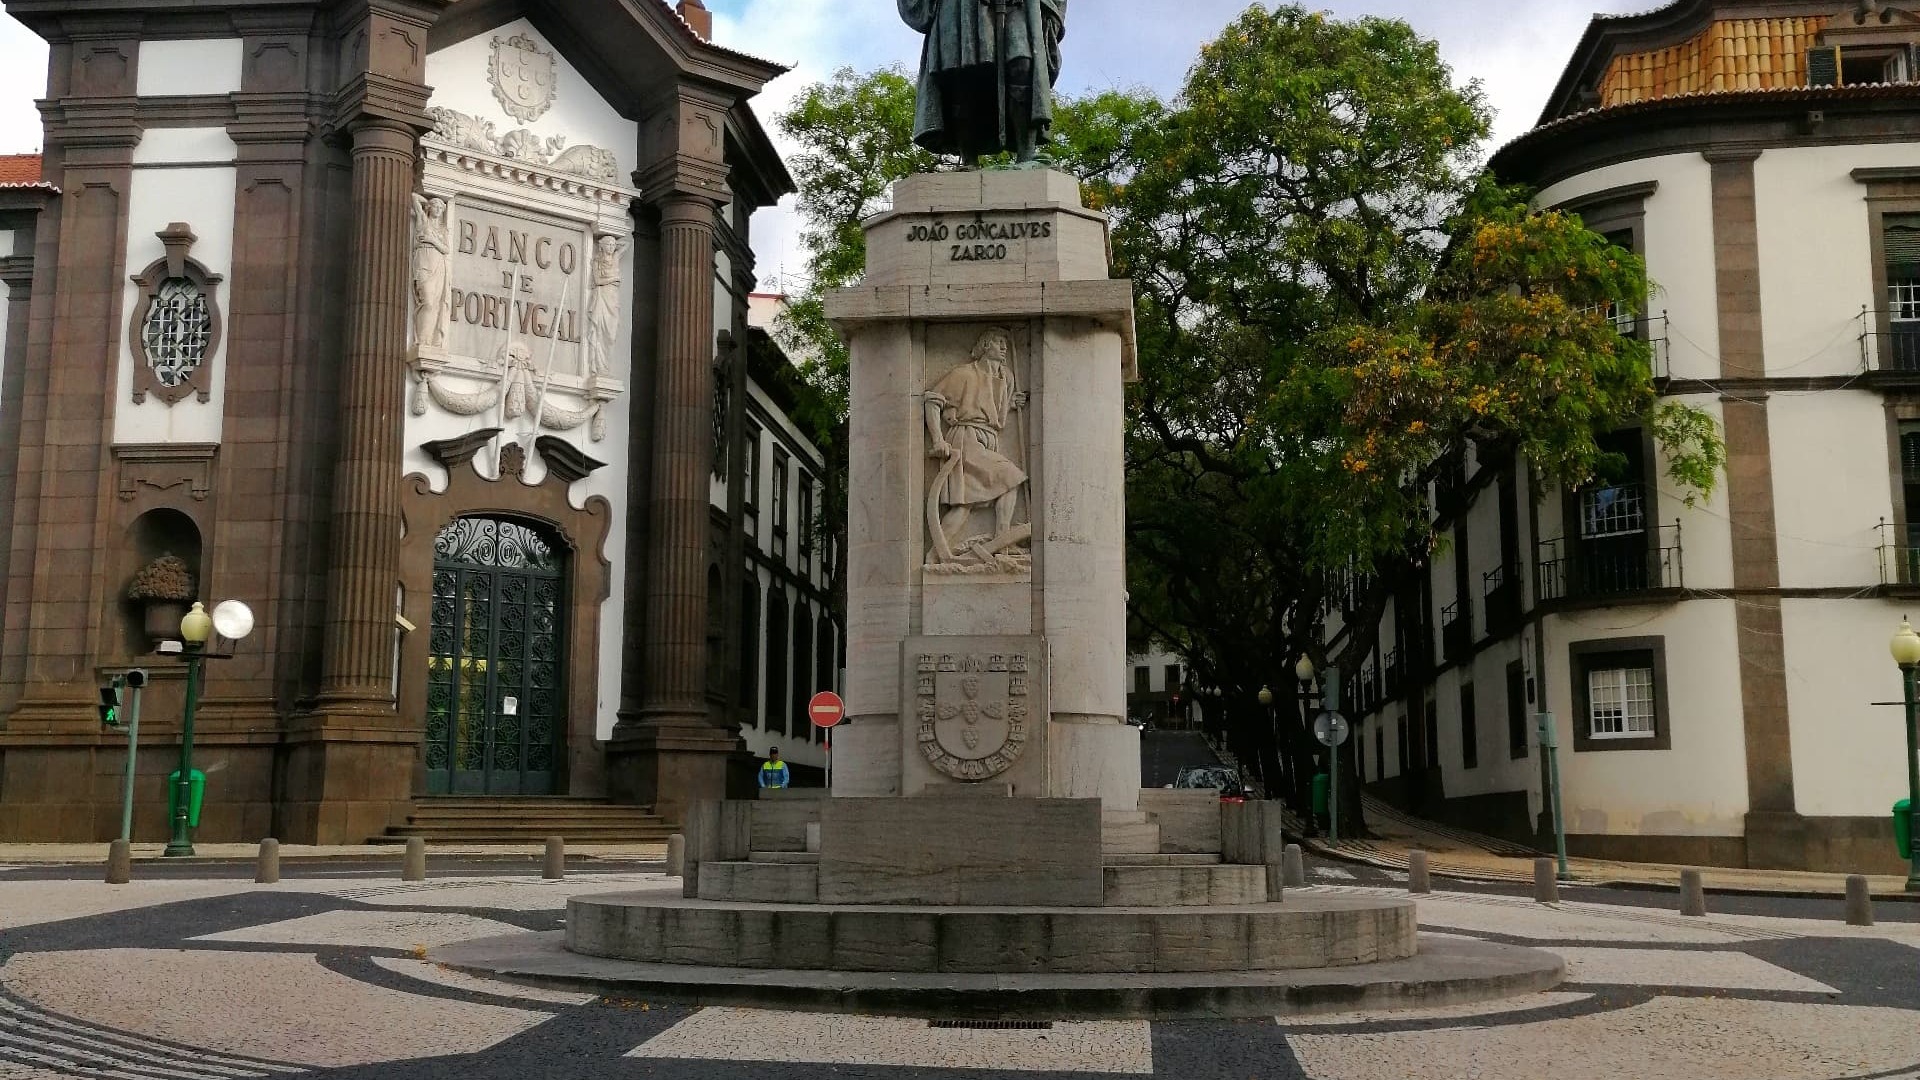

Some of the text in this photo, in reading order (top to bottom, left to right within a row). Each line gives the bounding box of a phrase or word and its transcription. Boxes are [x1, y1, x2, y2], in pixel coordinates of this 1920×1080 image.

[906, 220, 949, 242] JOÃO
[458, 219, 576, 275] BANCO
[951, 244, 1006, 261] ZARCO
[502, 270, 534, 294] DE
[450, 287, 581, 344] PORTVGAL
